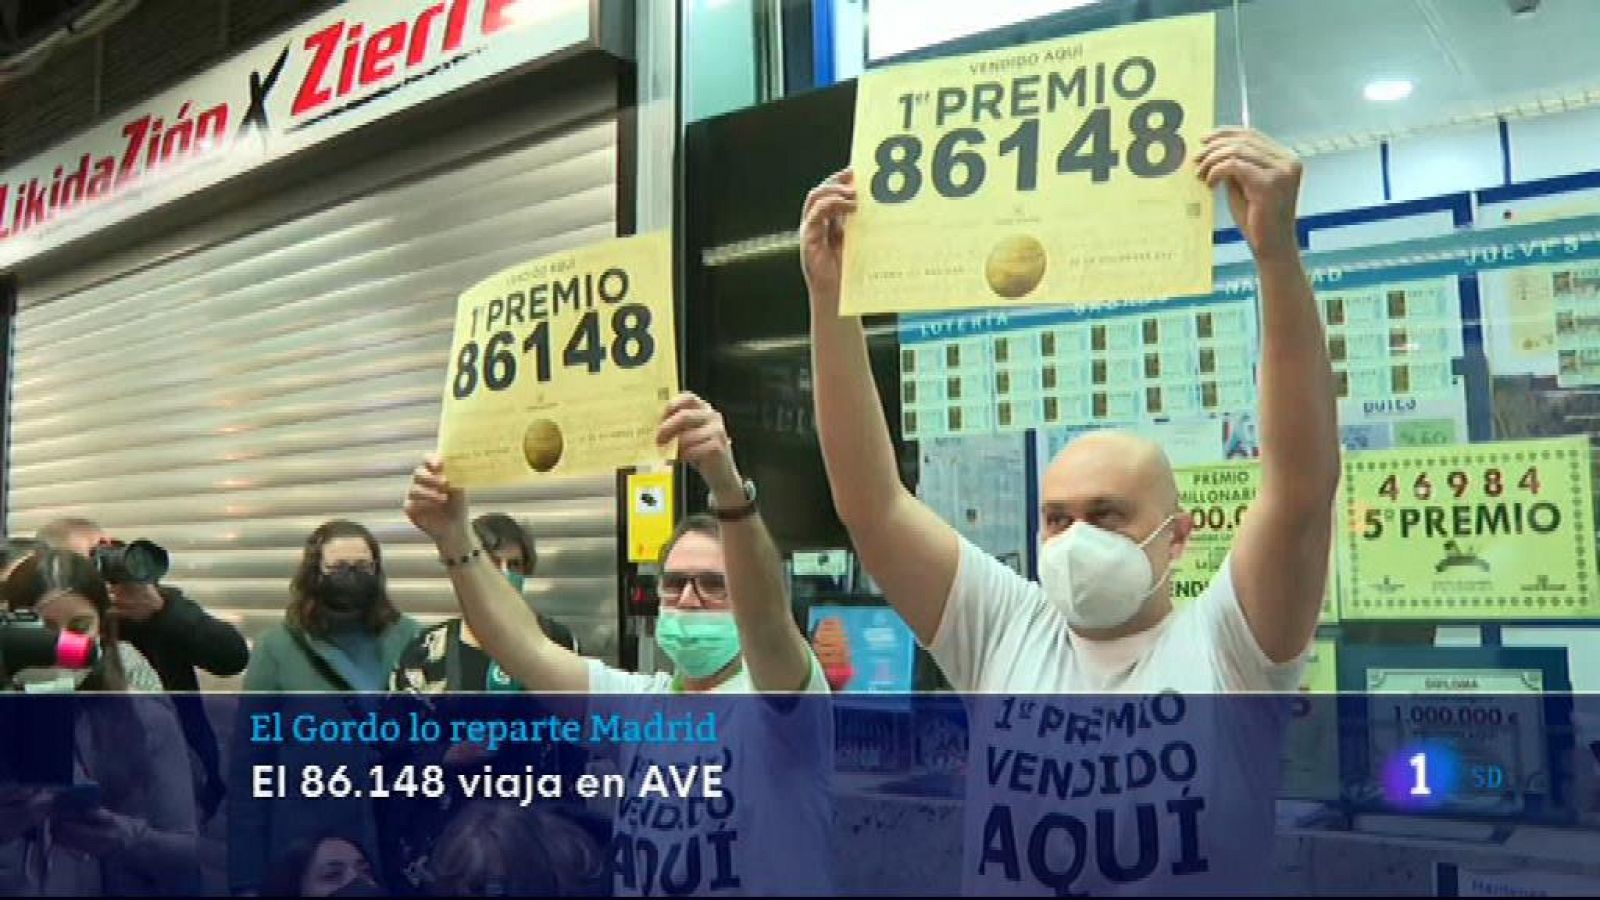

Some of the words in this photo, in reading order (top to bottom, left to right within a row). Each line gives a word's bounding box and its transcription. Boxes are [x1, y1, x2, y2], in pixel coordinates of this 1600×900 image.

[936, 55, 1157, 126] PREMIO
[969, 53, 1039, 75] VENDIDO
[869, 99, 1187, 204] 86148
[486, 268, 629, 331] PREMIO
[452, 302, 655, 399] 86148
[1193, 470, 1250, 485] PREMIO
[1400, 502, 1562, 538] PREMIO
[1037, 688, 1187, 745] PREMIO
[986, 740, 1197, 800] VENDIDO
[978, 786, 1209, 897] AQUÍ
